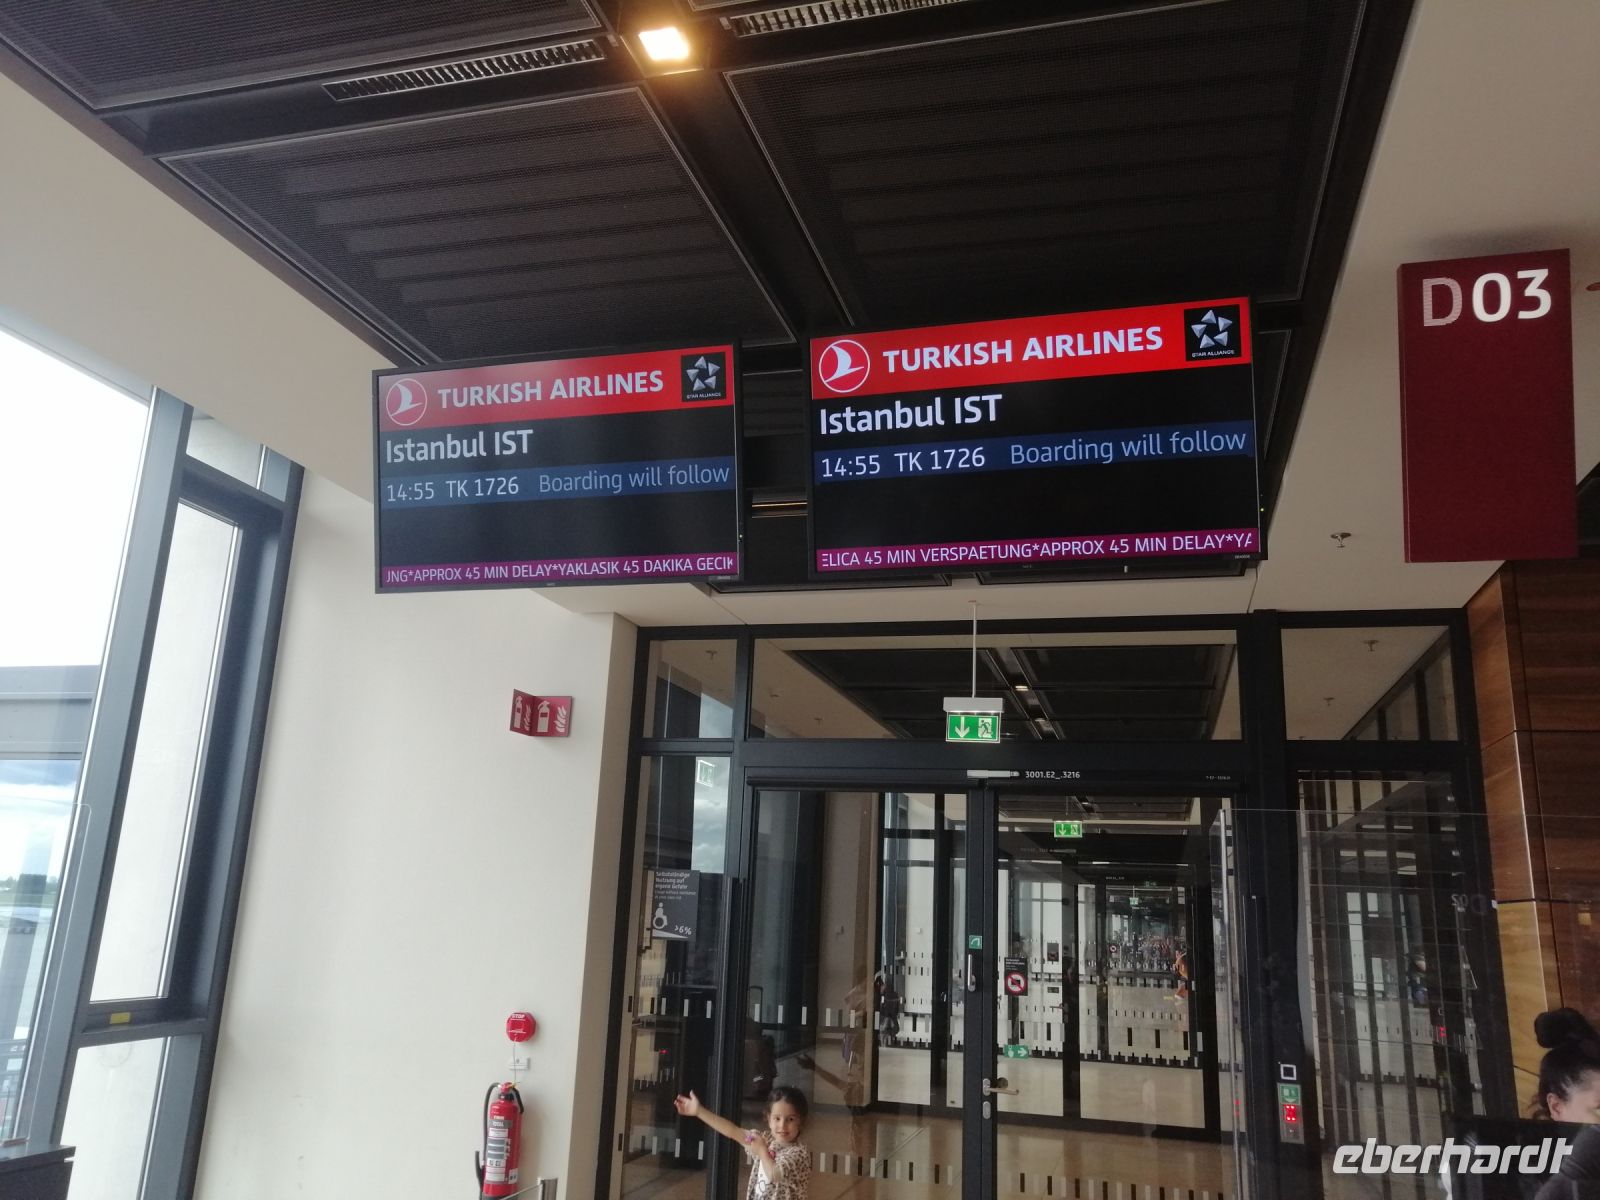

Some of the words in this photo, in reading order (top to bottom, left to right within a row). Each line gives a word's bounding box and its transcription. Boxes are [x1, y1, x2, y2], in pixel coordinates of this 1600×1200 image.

[1422, 268, 1551, 327] D03
[883, 340, 1012, 373] TURKISH
[1022, 326, 1163, 362] AIRLINES
[438, 381, 541, 408] TURKISH
[550, 370, 664, 400] AIRLINES
[820, 397, 944, 435] Istanbul
[955, 394, 1003, 425] IST
[386, 432, 487, 463] Istanbul
[494, 429, 533, 455] IST
[822, 454, 881, 478] 14:55
[894, 451, 922, 473] TK
[931, 447, 986, 470] 1726
[1011, 438, 1113, 466] Boarding
[1121, 434, 1162, 457] will
[1169, 430, 1247, 454] follow
[387, 481, 434, 502] 14:55
[446, 479, 468, 499] TK
[475, 476, 519, 497] 1726
[539, 470, 622, 494] Boarding
[629, 467, 662, 488] will
[667, 464, 730, 486] follow
[465, 566, 480, 580] 45
[484, 565, 508, 579] MIN
[623, 560, 640, 574] 45
[644, 558, 693, 573] DAKIKA
[864, 551, 882, 565] 45
[887, 549, 916, 564] MIN
[1110, 539, 1129, 553] 45
[1135, 537, 1167, 553] MIN
